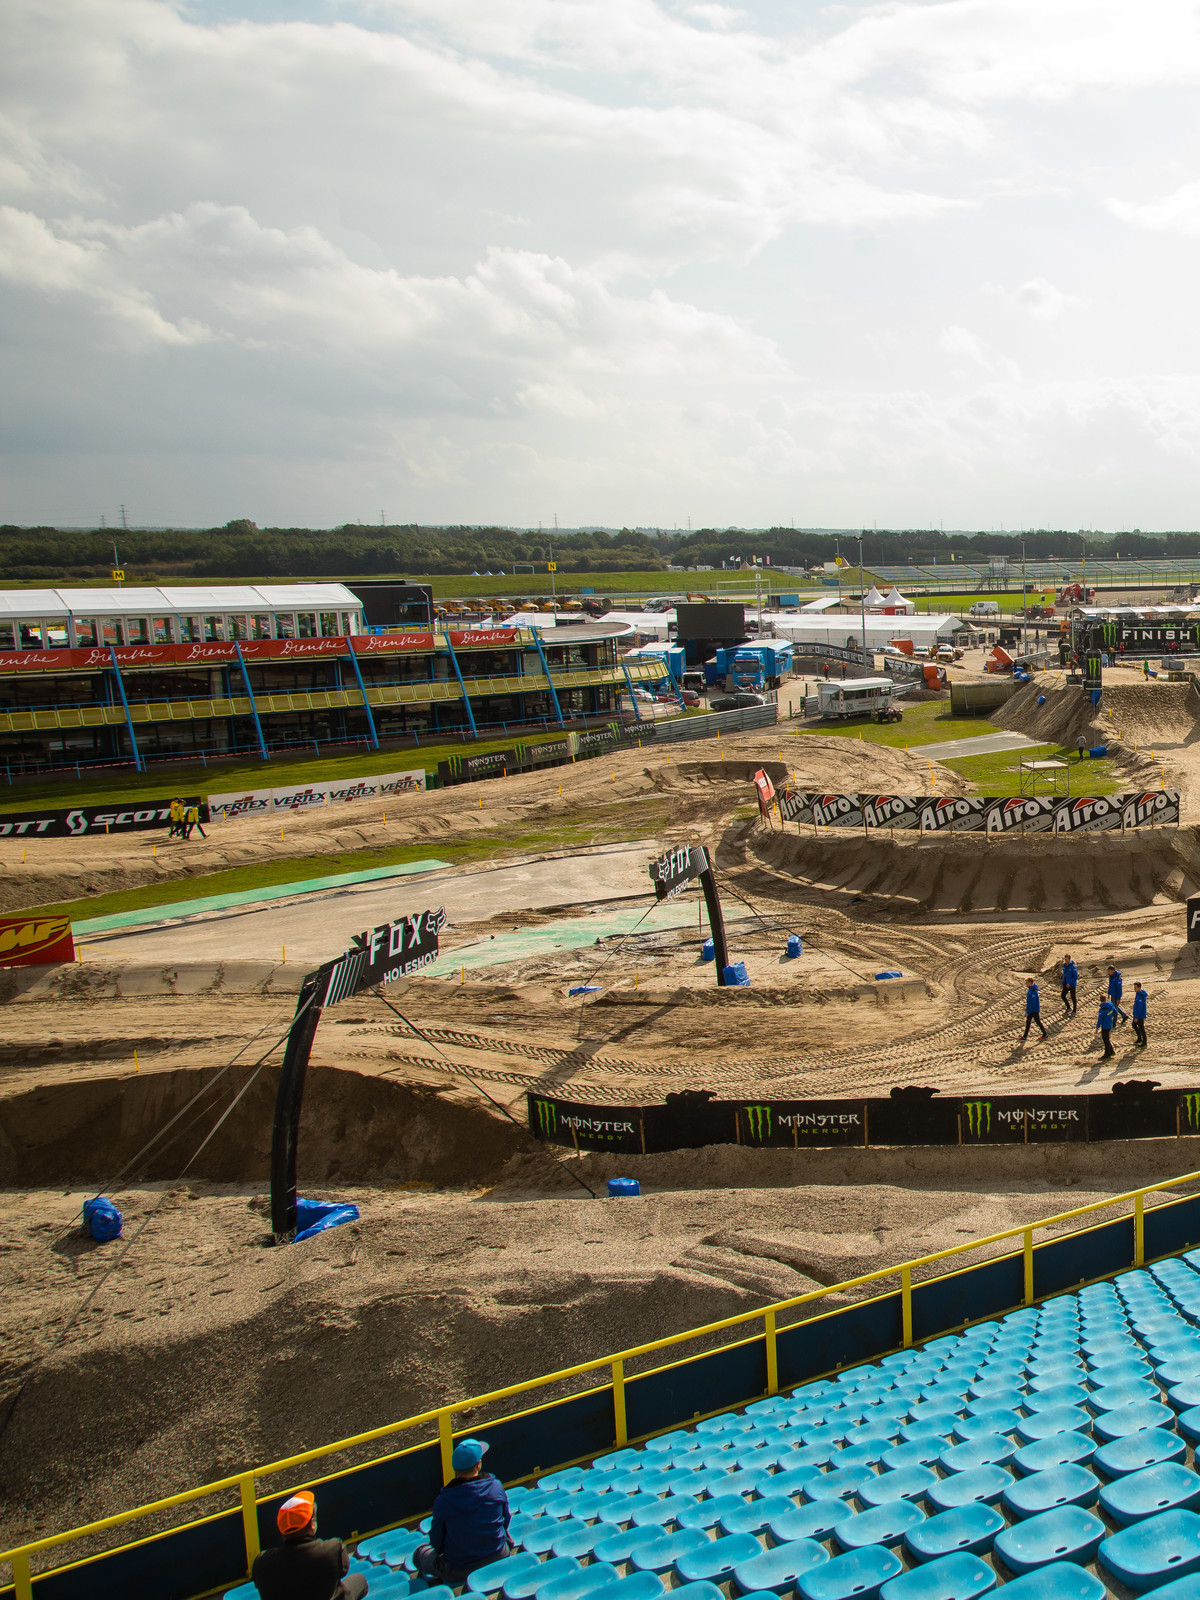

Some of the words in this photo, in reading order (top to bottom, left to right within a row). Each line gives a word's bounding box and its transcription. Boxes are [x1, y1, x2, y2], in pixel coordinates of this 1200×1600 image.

[115, 571, 124, 580] M
[1122, 630, 1191, 640] FINISH
[624, 723, 656, 734] MONSTER
[580, 731, 613, 744] MONSTER
[531, 742, 567, 755] MONSTER
[468, 754, 507, 767] MONSTER
[380, 779, 424, 791] VERTEX
[274, 792, 327, 805] VERTEX
[329, 786, 378, 799] VERTEX
[210, 799, 270, 813] VERTEX
[670, 844, 691, 879] FOX
[369, 915, 423, 966] FOX
[383, 949, 438, 986] HOLESHOT
[777, 1113, 861, 1127] MONSTER
[997, 1108, 1080, 1122] MONSTER
[560, 1113, 635, 1134] MONSTER
[1010, 1122, 1069, 1131] ENERGY
[579, 1131, 624, 1141] NERGY
